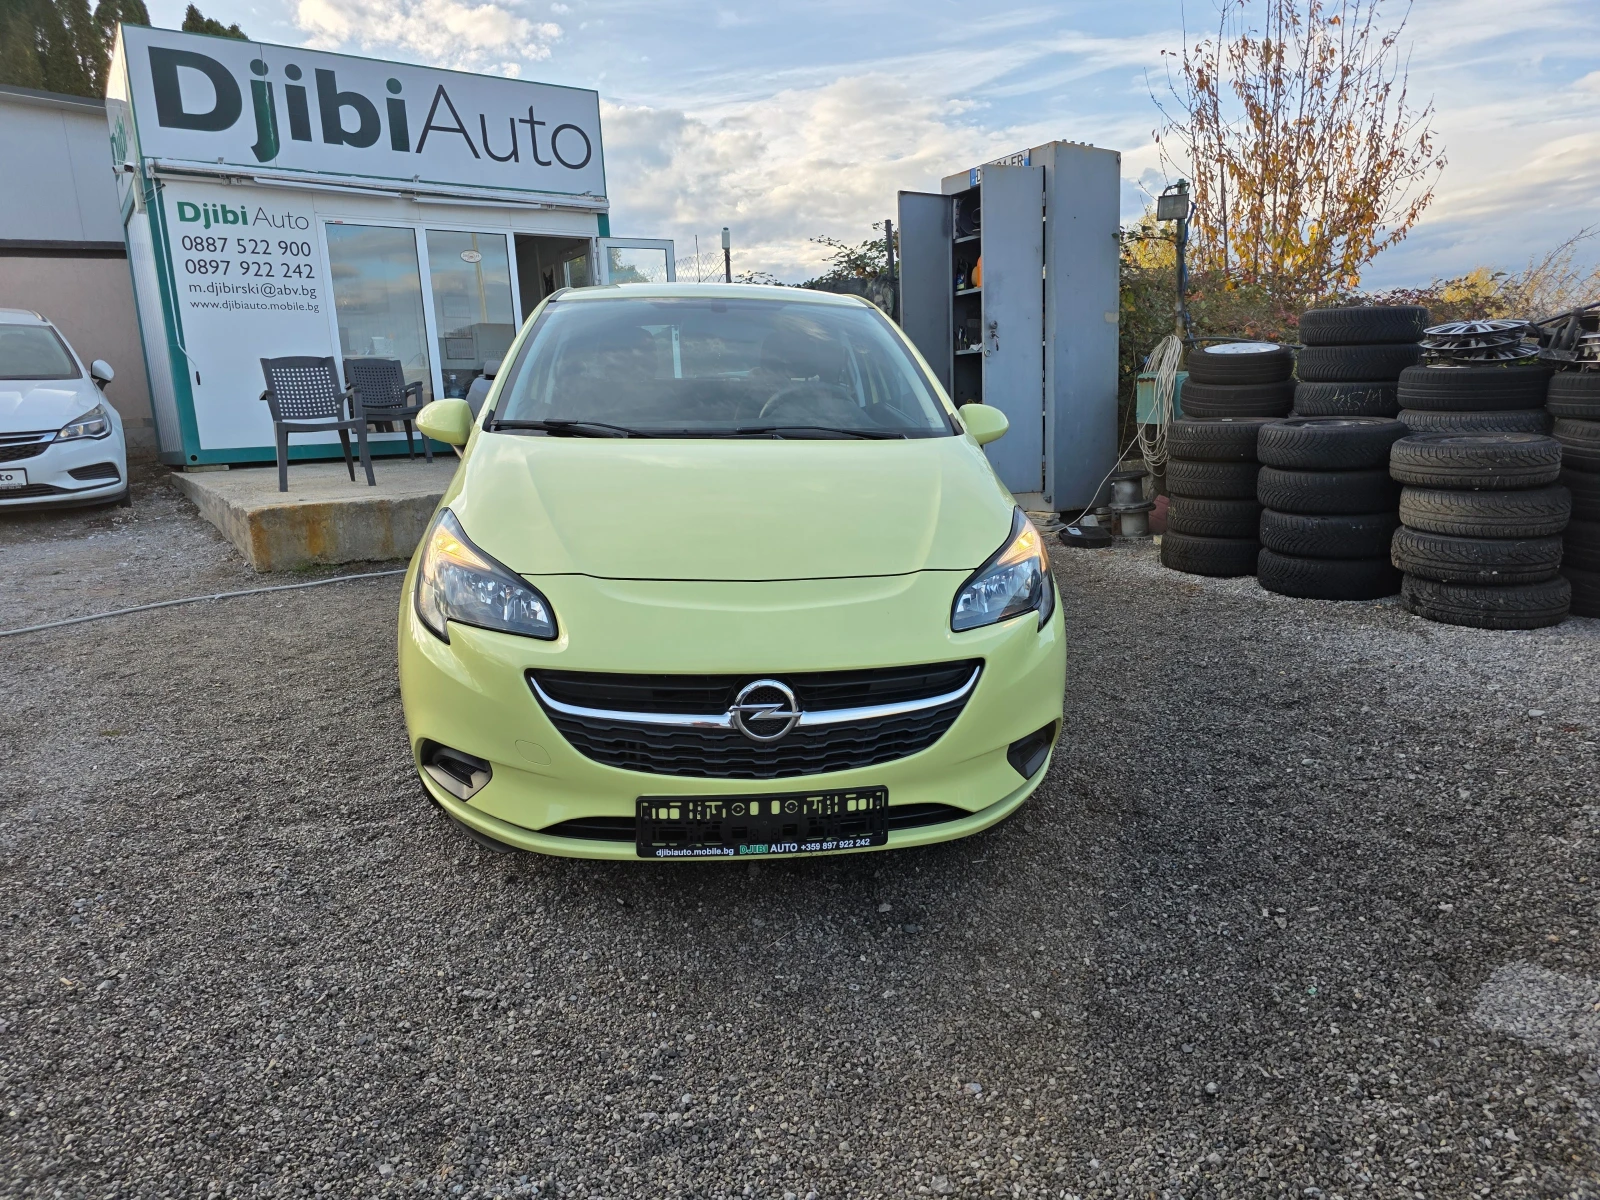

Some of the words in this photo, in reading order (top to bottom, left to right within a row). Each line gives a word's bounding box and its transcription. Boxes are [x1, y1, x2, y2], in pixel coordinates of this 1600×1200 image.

[177, 201, 248, 229] Djibi
[253, 207, 309, 230] Auto
[182, 235, 228, 252] 0887
[237, 239, 272, 255] 522
[278, 240, 311, 257] 900
[185, 259, 231, 275] 0897
[240, 261, 275, 278] 922
[281, 263, 315, 279] 242
[189, 282, 317, 299] m.djibirski@abv.bg
[190, 300, 320, 313] www.djibiauto.mobile.bg
[656, 847, 734, 857] djibiauto.mobile.bg
[739, 844, 768, 854] DJIBI
[770, 843, 798, 853] AUTO
[800, 842, 821, 851] +359
[822, 841, 837, 850] 897
[839, 839, 854, 848] 922
[855, 838, 870, 847] 242
